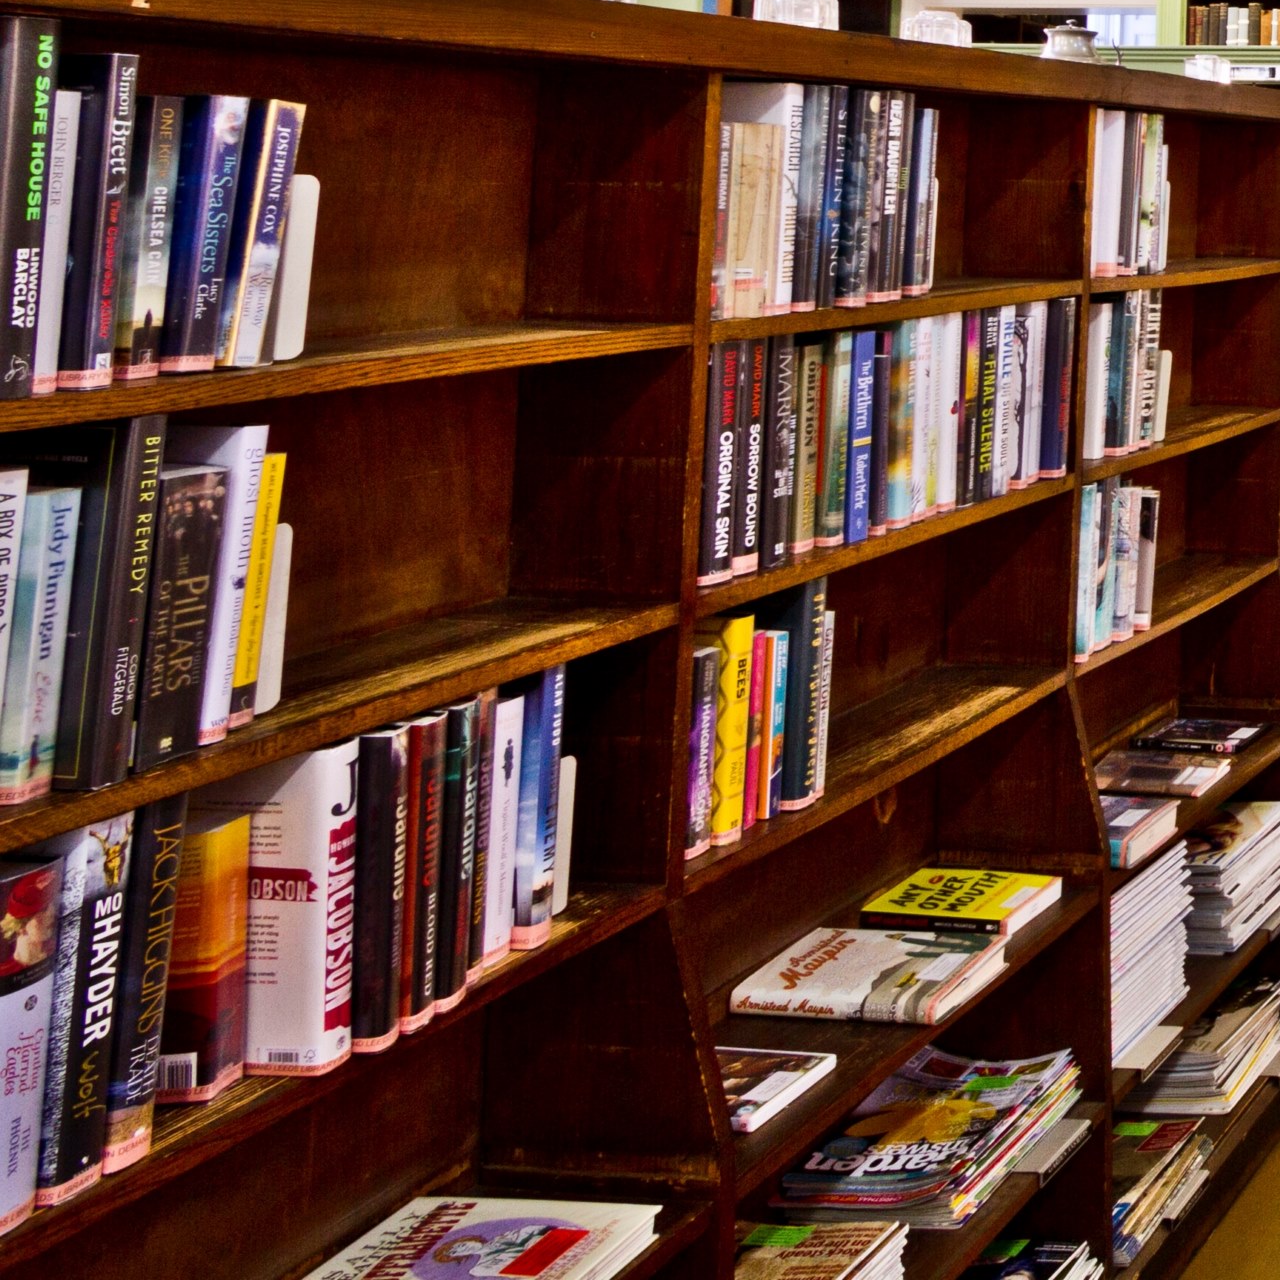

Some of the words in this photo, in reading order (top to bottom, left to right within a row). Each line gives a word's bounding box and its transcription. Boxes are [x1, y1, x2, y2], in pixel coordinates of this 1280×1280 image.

[37, 35, 53, 69] NO
[33, 76, 50, 135] SAFE
[118, 67, 135, 115] Simon
[55, 116, 69, 151] JOHN
[159, 108, 174, 140] ONE
[720, 126, 731, 148] FAYE
[789, 105, 802, 171] RESEARCH
[888, 100, 903, 136] DEAR
[111, 119, 132, 175] Brett
[223, 155, 237, 173] The
[267, 125, 292, 202] JOSEPHINE
[832, 110, 848, 202] STEPHEN
[26, 142, 45, 221] HOUSE
[49, 156, 65, 206] BERGER
[208, 175, 233, 208] Sea
[718, 152, 729, 209] KELLERMAN
[883, 140, 900, 215] DAUGHTER
[109, 200, 121, 222] The
[149, 187, 168, 246] CHELSEA
[262, 206, 277, 233] COX
[102, 226, 118, 295] Cinderella
[201, 212, 228, 272] Sisters
[829, 222, 841, 276] KING
[11, 248, 29, 327] BARCLAY
[25, 248, 41, 327] LINWOOD
[146, 251, 162, 283] CAIN
[207, 278, 222, 303] Lucy
[98, 300, 112, 339] Killer
[194, 284, 209, 319] Clarke
[723, 351, 738, 387] DAVID
[752, 346, 764, 380] DAVID
[860, 360, 873, 375] The
[1002, 322, 1015, 379] NEVILLE
[750, 383, 762, 418] MARK
[804, 361, 817, 448] OBLIVION
[855, 376, 874, 430] Brethren
[982, 360, 996, 404] FINAL
[721, 390, 736, 425] MARK
[1001, 401, 1011, 434] STOLEN
[746, 423, 761, 491] SORROW
[979, 408, 994, 473] SILENCE
[1000, 437, 1009, 467] SOULS
[138, 436, 161, 502] BITTER
[716, 431, 734, 514] ORIGINAL
[855, 455, 868, 483] Robert
[743, 493, 759, 547] BOUND
[854, 484, 866, 509] Merle
[47, 505, 72, 554] Judy
[714, 517, 731, 558] SKIN
[129, 514, 153, 595] REMEDY
[37, 560, 66, 660] Finnigan
[158, 581, 172, 604] OF
[154, 608, 169, 640] THE
[110, 647, 130, 715] FITZGERALD
[125, 654, 139, 700] CONOR
[149, 644, 166, 697] EARTH
[553, 673, 564, 706] ALAN
[736, 658, 748, 699] BEES
[820, 627, 834, 711] GALVESTON
[552, 713, 562, 746] JUDD
[697, 704, 711, 785] HANGMAN'S
[694, 789, 707, 832] SONG
[151, 822, 182, 899] JACK
[94, 892, 122, 918] MO
[887, 883, 932, 908] ANY
[917, 874, 974, 910] OTHER
[942, 872, 1004, 913] MOUTH
[325, 855, 356, 1013] JACOBSON
[424, 892, 438, 954] BLOOD
[137, 909, 174, 1034] HIGGINS
[777, 936, 857, 991] Maupin
[789, 929, 847, 968] Armistead
[81, 919, 121, 1048] HAYDER
[423, 959, 435, 995] RED
[736, 995, 790, 1013] Armistead
[792, 998, 835, 1017] Maupin
[1, 1047, 23, 1096] Eagles
[15, 1032, 34, 1096] Harrod-
[28, 1028, 45, 1090] Cynthia
[125, 1039, 147, 1105] TRADE
[141, 1034, 160, 1096] DEATH
[6, 1117, 22, 1176] PHOENIX
[19, 1127, 31, 1153] THE
[57, 1174, 96, 1198] LIBRARY
